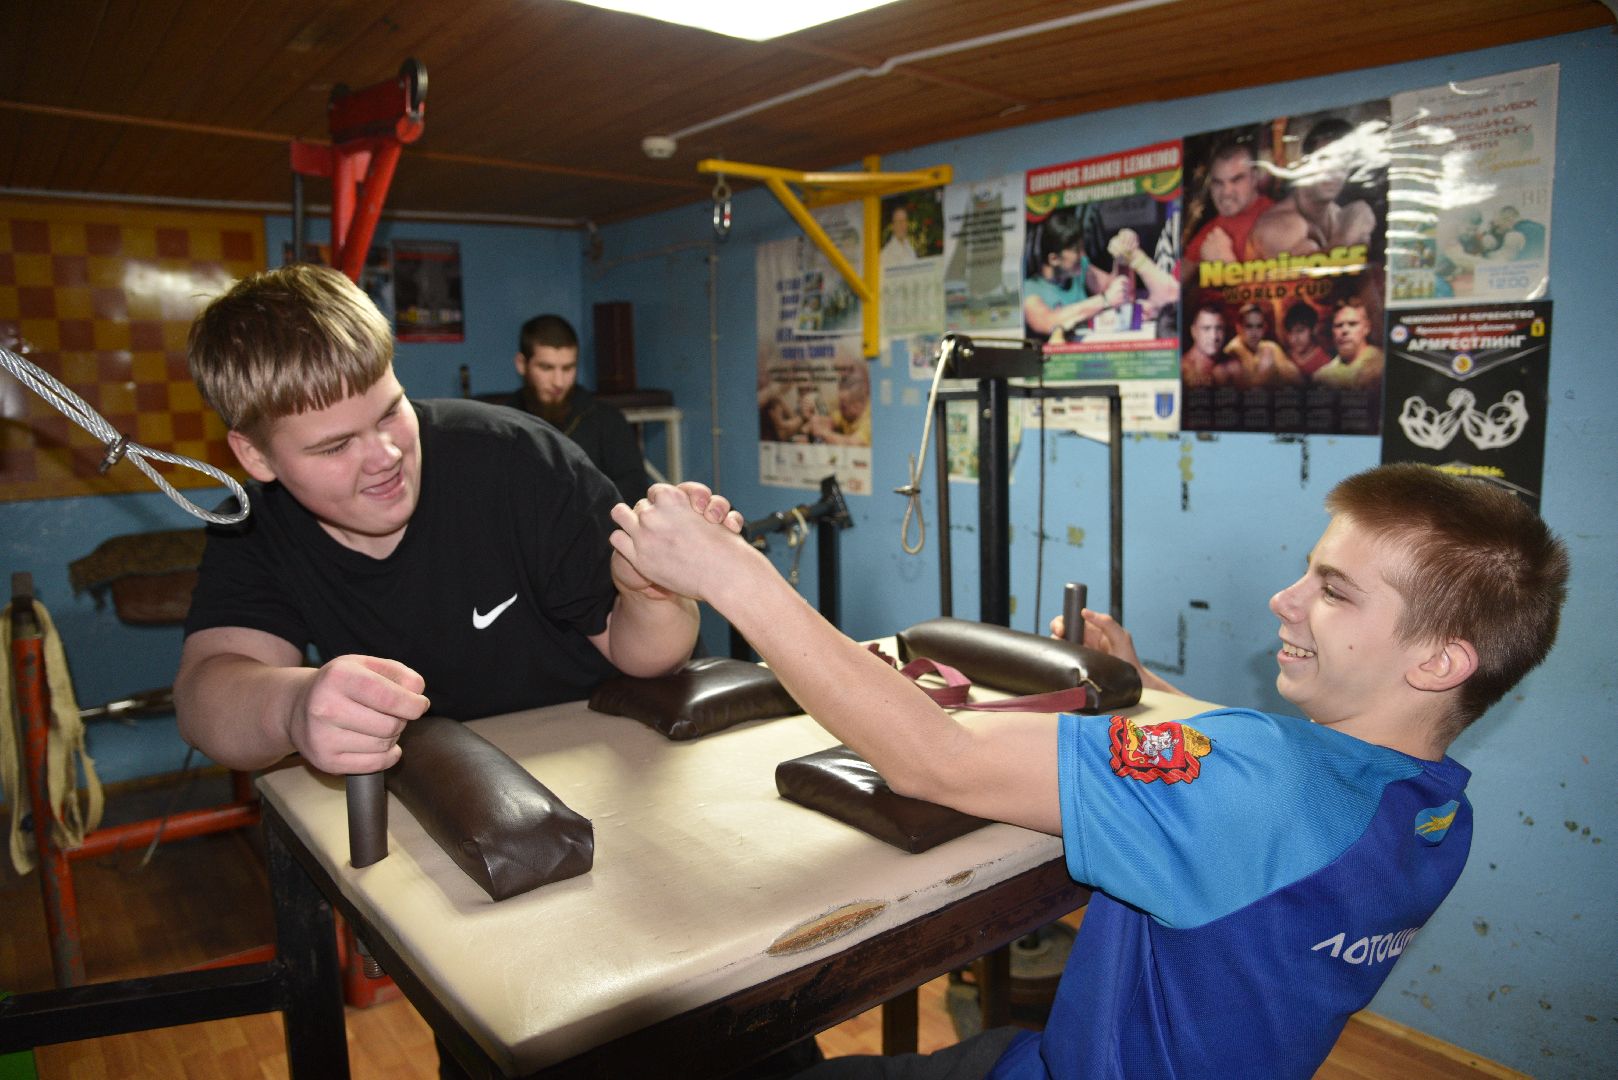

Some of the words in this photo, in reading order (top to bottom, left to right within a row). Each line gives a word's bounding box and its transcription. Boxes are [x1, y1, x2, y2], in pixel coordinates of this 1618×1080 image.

[1199, 245, 1368, 288] Nemiroff
[1223, 286, 1287, 303] WORLD
[1295, 282, 1333, 299] CUP
[1407, 335, 1527, 352] АРМРЕСТЛИНГ
